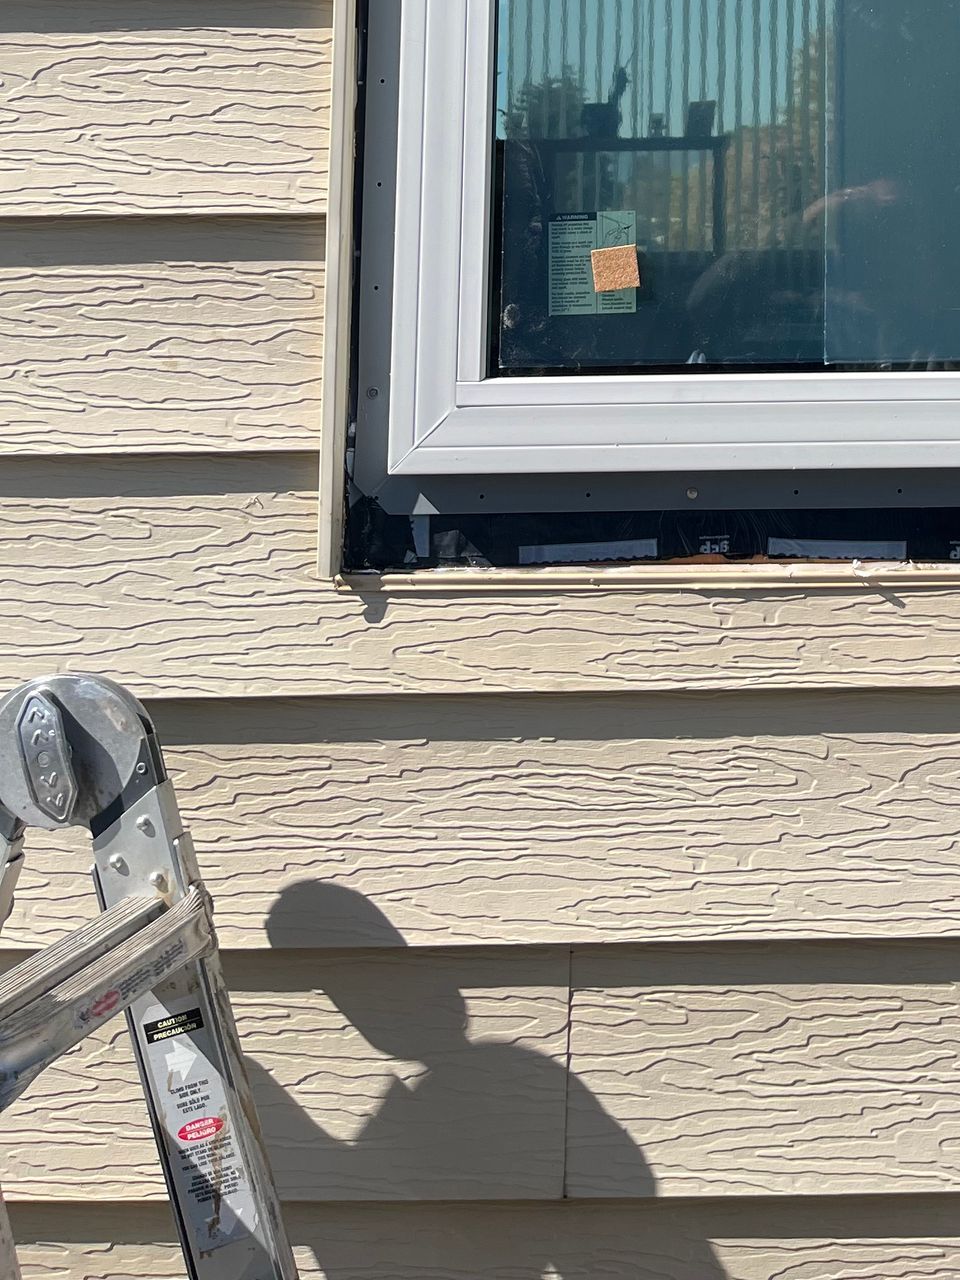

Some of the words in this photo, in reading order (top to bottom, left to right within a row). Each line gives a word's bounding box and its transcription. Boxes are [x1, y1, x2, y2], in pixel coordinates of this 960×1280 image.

[157, 1014, 188, 1029] CAUTION
[185, 1118, 214, 1131] DANGER
[187, 1126, 216, 1139] PELIGRO
